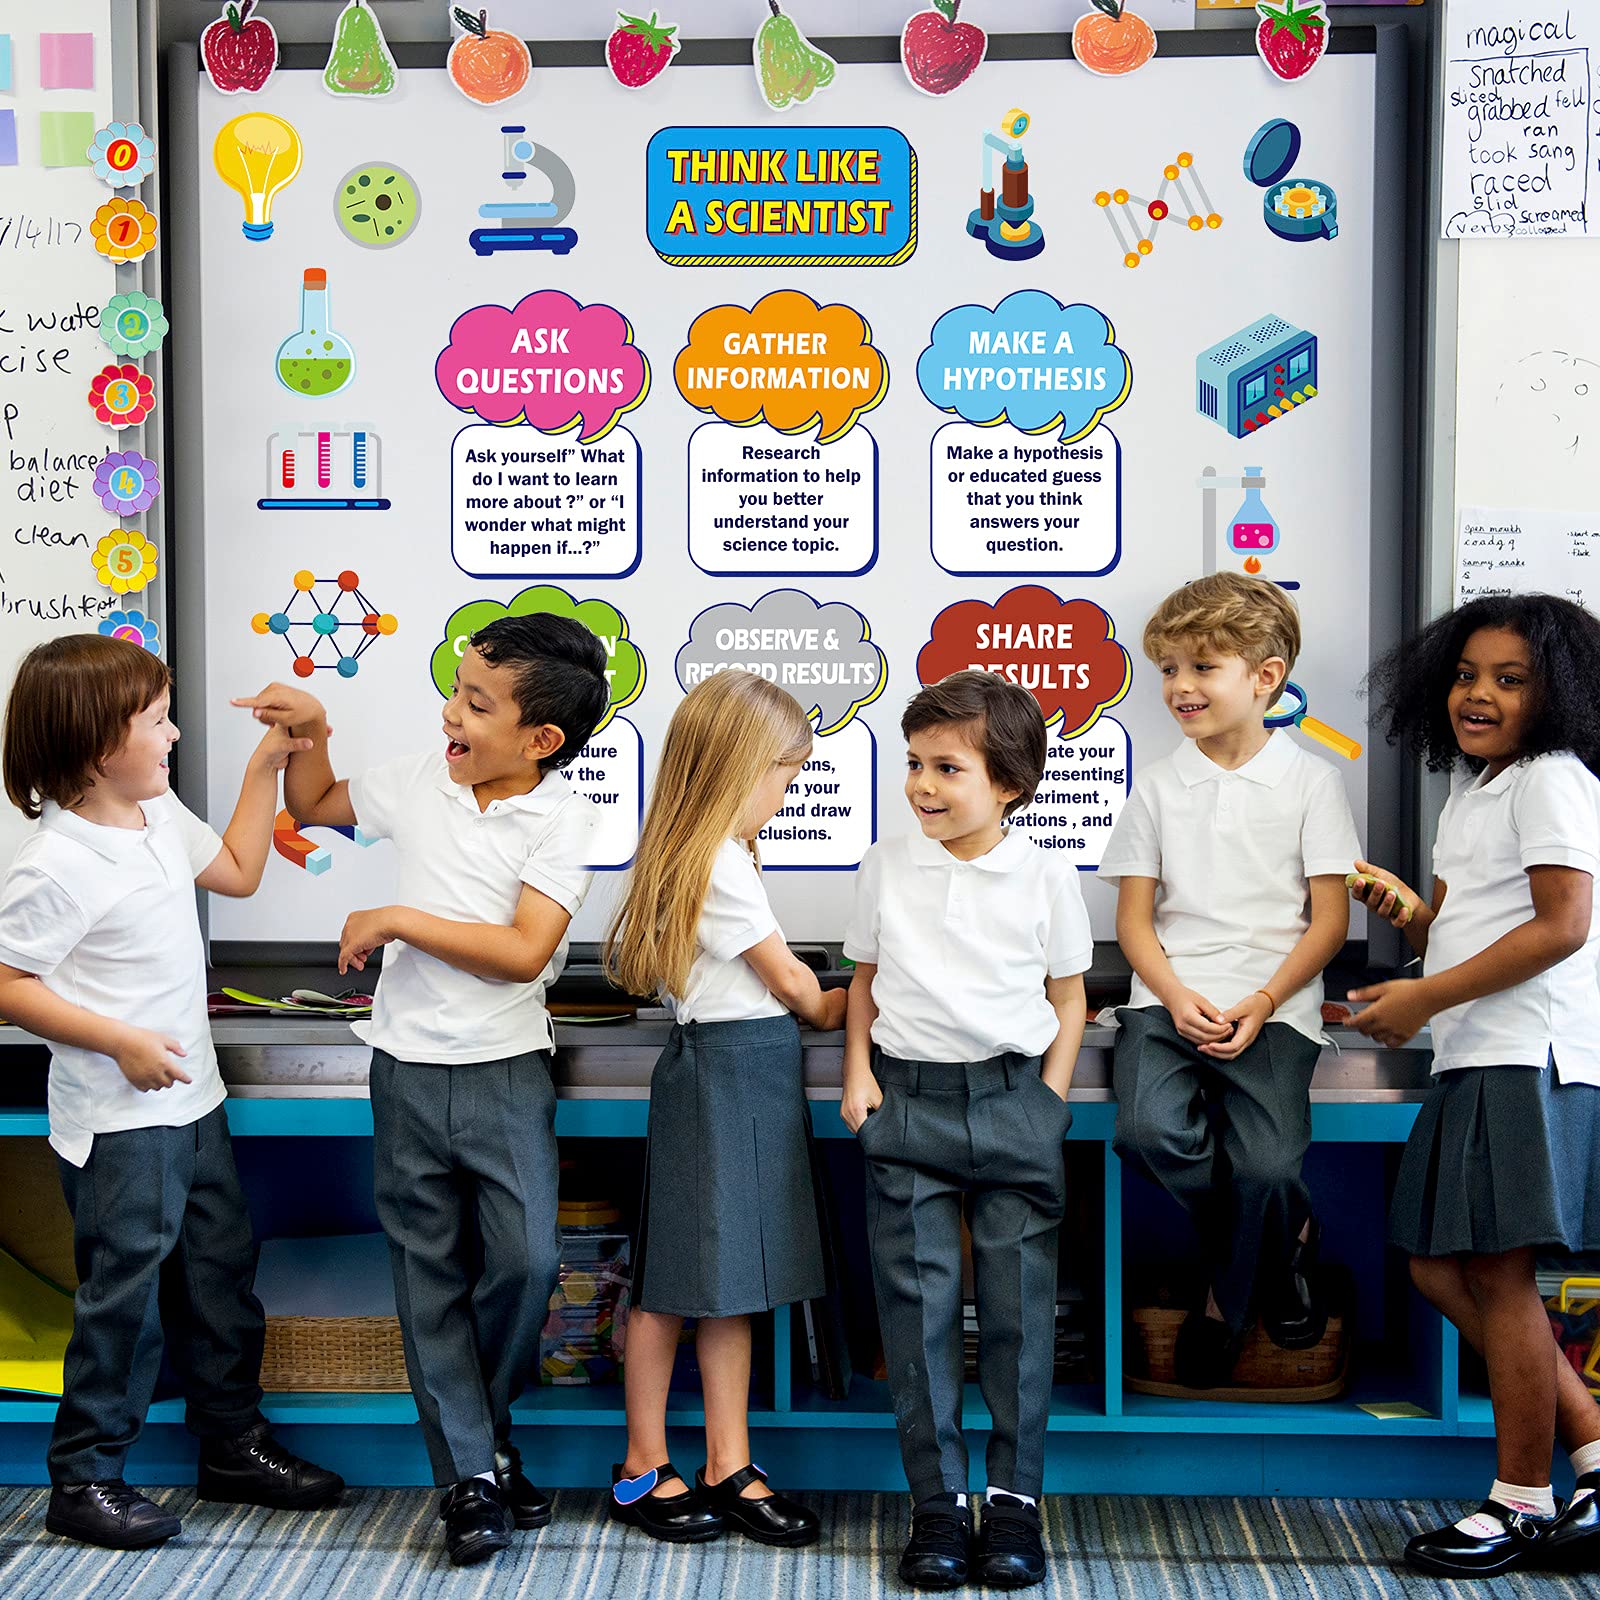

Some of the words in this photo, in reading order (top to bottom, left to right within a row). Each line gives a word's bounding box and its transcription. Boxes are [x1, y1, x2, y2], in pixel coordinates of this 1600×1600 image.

[1467, 9, 1577, 55] magical
[1556, 86, 1585, 108] fell
[1468, 95, 1551, 142] grabbed
[1523, 125, 1558, 137] ran
[113, 144, 131, 167] 0
[1469, 141, 1517, 163] took
[1529, 143, 1575, 170] sang
[666, 149, 788, 185] THINK
[796, 149, 881, 185] LIKE
[1470, 162, 1551, 195] raced
[1474, 193, 1518, 211] slid
[1519, 201, 1588, 223] screamed
[664, 200, 698, 235] A
[705, 199, 893, 236] SCIENTIST
[27, 302, 101, 332] wate
[123, 313, 144, 336] 2
[510, 328, 570, 354] ASK
[723, 332, 828, 355] GATHER
[969, 331, 1046, 354] MAKE
[1053, 331, 1074, 354] A
[456, 368, 624, 394] QUESTIONS
[687, 367, 870, 390] INFORMATION
[943, 367, 1107, 391] HYPOTHESIS
[113, 384, 129, 408] 3
[465, 449, 497, 463] Ask
[581, 449, 625, 463] What
[742, 446, 820, 460] Research
[946, 446, 993, 460] Make
[998, 449, 1008, 460] a
[1013, 446, 1103, 463] hypothesis
[118, 471, 136, 494] 4
[472, 472, 493, 486] do
[498, 472, 502, 486] I
[508, 474, 549, 486] want
[554, 473, 570, 486] to
[576, 472, 618, 486] learn
[702, 469, 798, 483] information
[803, 469, 820, 483] to
[825, 469, 861, 485] help
[948, 472, 964, 483] or
[969, 469, 1047, 483] educated
[1052, 472, 1102, 485] guess
[17, 476, 79, 502] diet
[739, 495, 768, 508] you
[773, 492, 824, 506] better
[967, 492, 1001, 506] that
[1006, 495, 1035, 508] you
[1039, 492, 1083, 506] think
[466, 498, 509, 509] more
[513, 495, 562, 509] about
[589, 498, 606, 509] or
[465, 518, 526, 532] wonder
[531, 518, 572, 532] what
[577, 518, 626, 534] might
[714, 515, 809, 529] understand
[814, 518, 849, 531] your
[970, 517, 1039, 529] answers
[1044, 518, 1080, 531] your
[14, 525, 89, 548] clean
[723, 538, 788, 552] science
[792, 538, 839, 554] topic.
[986, 538, 1063, 554] question.
[490, 541, 551, 557] happen
[117, 550, 133, 573] 5
[715, 628, 819, 651] OBSERVE
[823, 628, 840, 651] &
[975, 623, 1073, 649] SHARE
[685, 662, 777, 684] RERD
[782, 662, 875, 685] RESULTS
[967, 663, 1090, 690] SULTS
[1079, 748, 1115, 761] your
[578, 767, 605, 781] the
[804, 783, 840, 797] your
[811, 803, 851, 817] draw
[1082, 813, 1112, 827] and
[755, 826, 831, 840] clusions.
